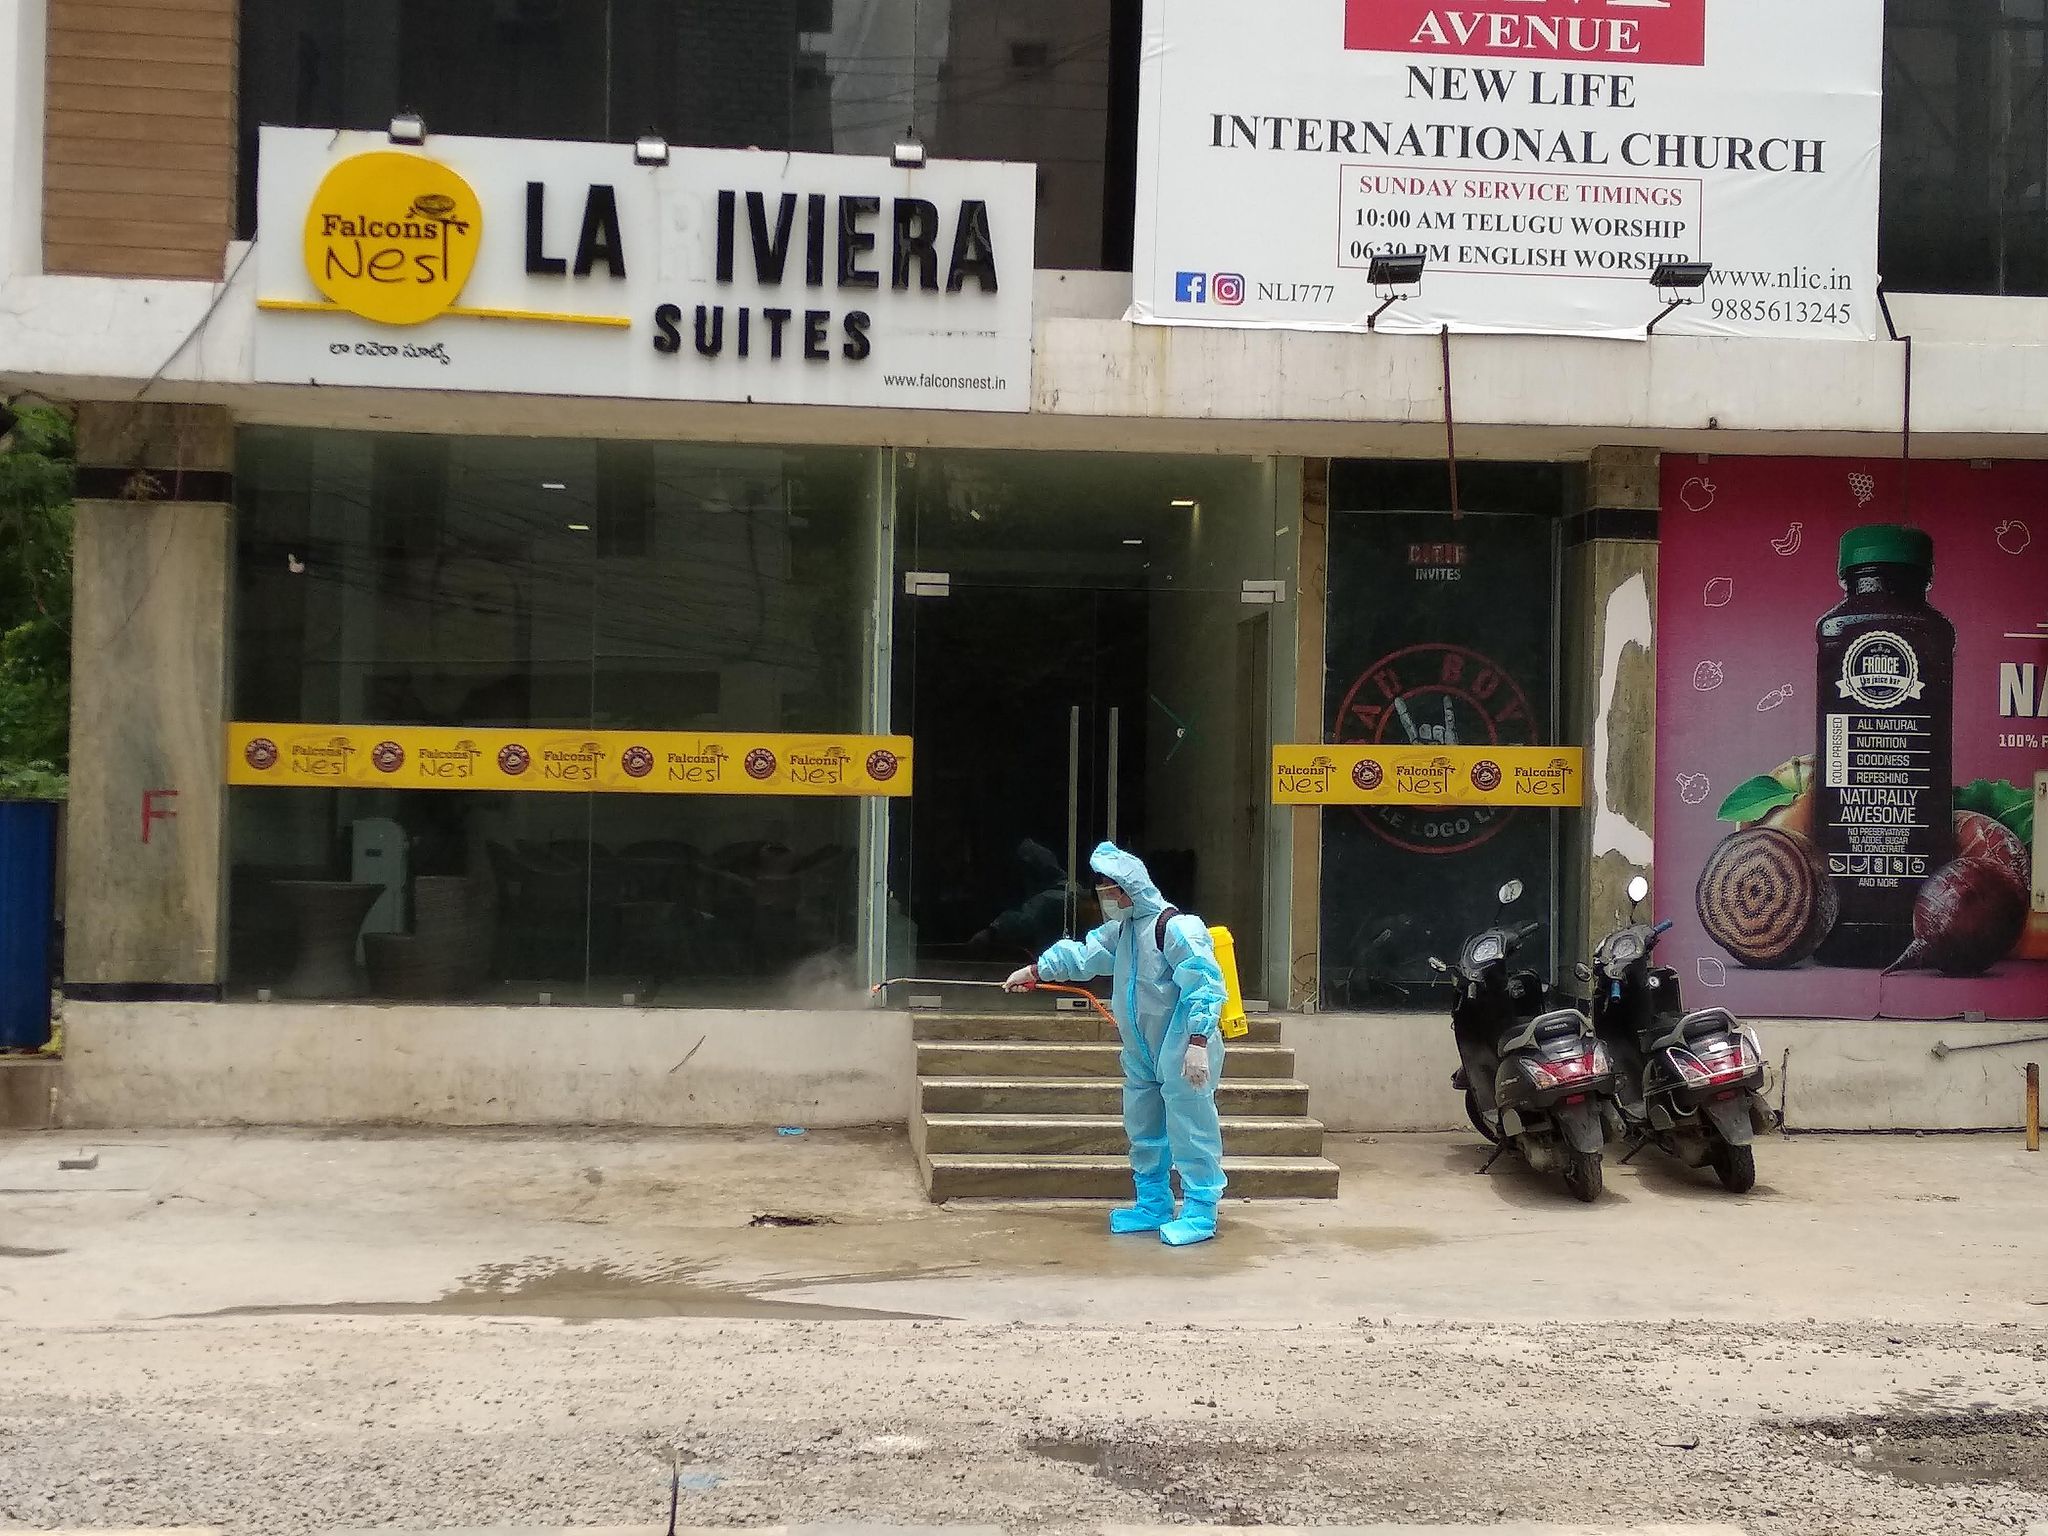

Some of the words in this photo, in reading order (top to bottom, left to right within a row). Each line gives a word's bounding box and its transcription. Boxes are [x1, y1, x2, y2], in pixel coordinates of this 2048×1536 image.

[1408, 10, 1641, 54] AVENUE
[1405, 65, 1517, 102] NEW
[1529, 71, 1636, 108] LIFE
[1209, 112, 1609, 166] INTERNATIONAL
[1620, 131, 1826, 174] CHURCH
[1359, 175, 1457, 198] SUNDAY
[1464, 179, 1569, 203] SERVICE
[1576, 184, 1683, 207] TIMINGS
[322, 213, 437, 239] Falcons
[525, 181, 627, 280] LA
[1355, 207, 1411, 229] 10:00
[1417, 211, 1455, 230] AM
[1463, 213, 1563, 235] TELUGU
[1571, 217, 1686, 239] WORSHIP
[325, 220, 458, 284] Nest
[1458, 244, 1566, 267] ENGLISH
[1709, 266, 1852, 290] www.nlic.in
[1257, 282, 1335, 303] NLI777
[1711, 298, 1851, 324] 9885613245
[653, 303, 872, 360] SUITES
[884, 373, 1006, 390] www.falconsnest.in
[1415, 568, 1462, 581] INVITES
[2000, 662, 2048, 717] N
[1857, 719, 1874, 731] ALL
[1876, 719, 1918, 731] NATURAL
[1832, 717, 1842, 758] PRESSED
[1856, 736, 1907, 749] NUTRITION
[1999, 733, 2038, 748] 100%
[544, 750, 593, 764] Falcons
[668, 752, 716, 765] Falcons
[790, 754, 838, 767] Falcons
[1856, 754, 1910, 767] GOODNESS
[790, 756, 846, 785] Nest
[1277, 765, 1324, 776] Falcons
[1278, 765, 1331, 793] Nest
[1397, 766, 1443, 777] Falcons
[1514, 767, 1561, 778] Falcons
[1515, 768, 1568, 795] Nest
[1832, 760, 1842, 785] COLD
[1840, 788, 1918, 806] NATURALLY
[142, 789, 179, 844] F
[1840, 806, 1916, 824] AWESOME
